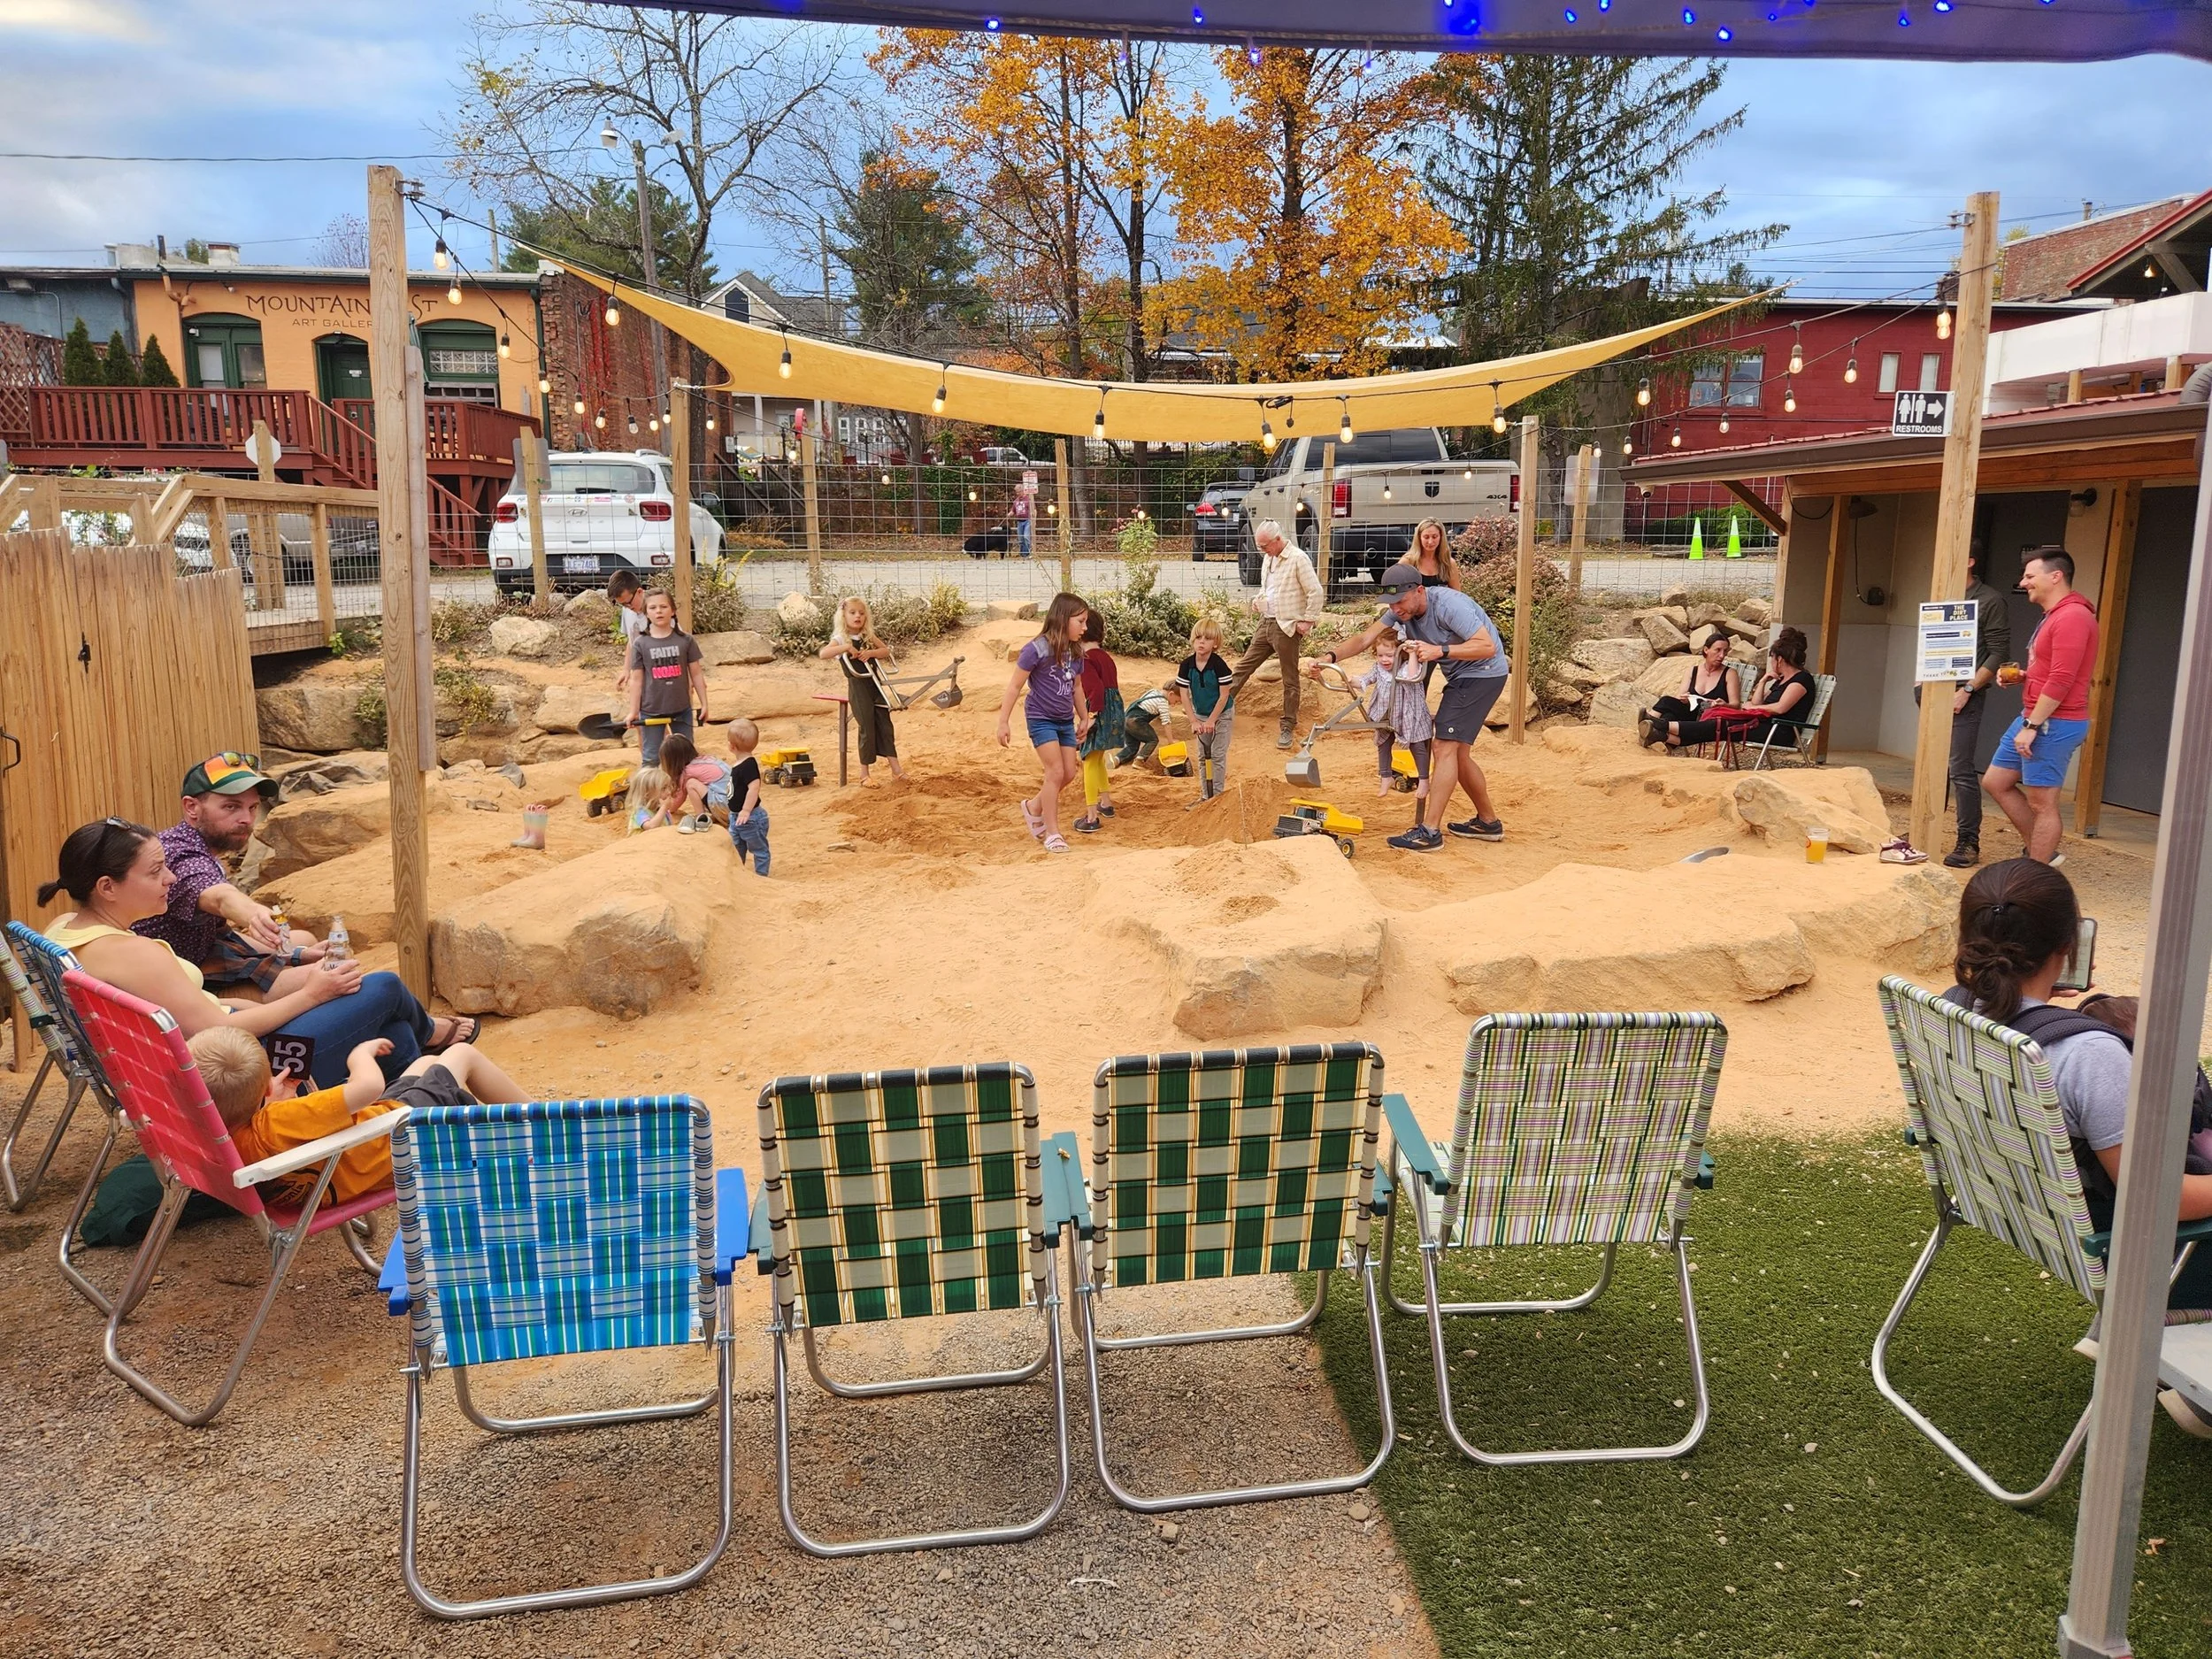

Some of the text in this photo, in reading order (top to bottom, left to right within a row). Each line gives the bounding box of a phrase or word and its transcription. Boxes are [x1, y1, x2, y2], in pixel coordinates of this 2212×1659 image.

[245, 295, 371, 318] MOUNTAIN
[322, 319, 373, 328] GALLER
[1895, 425, 1943, 434] RESTROOMS
[649, 645, 680, 659] FAITH
[652, 664, 681, 679] NOAH
[272, 1041, 307, 1073] 55
